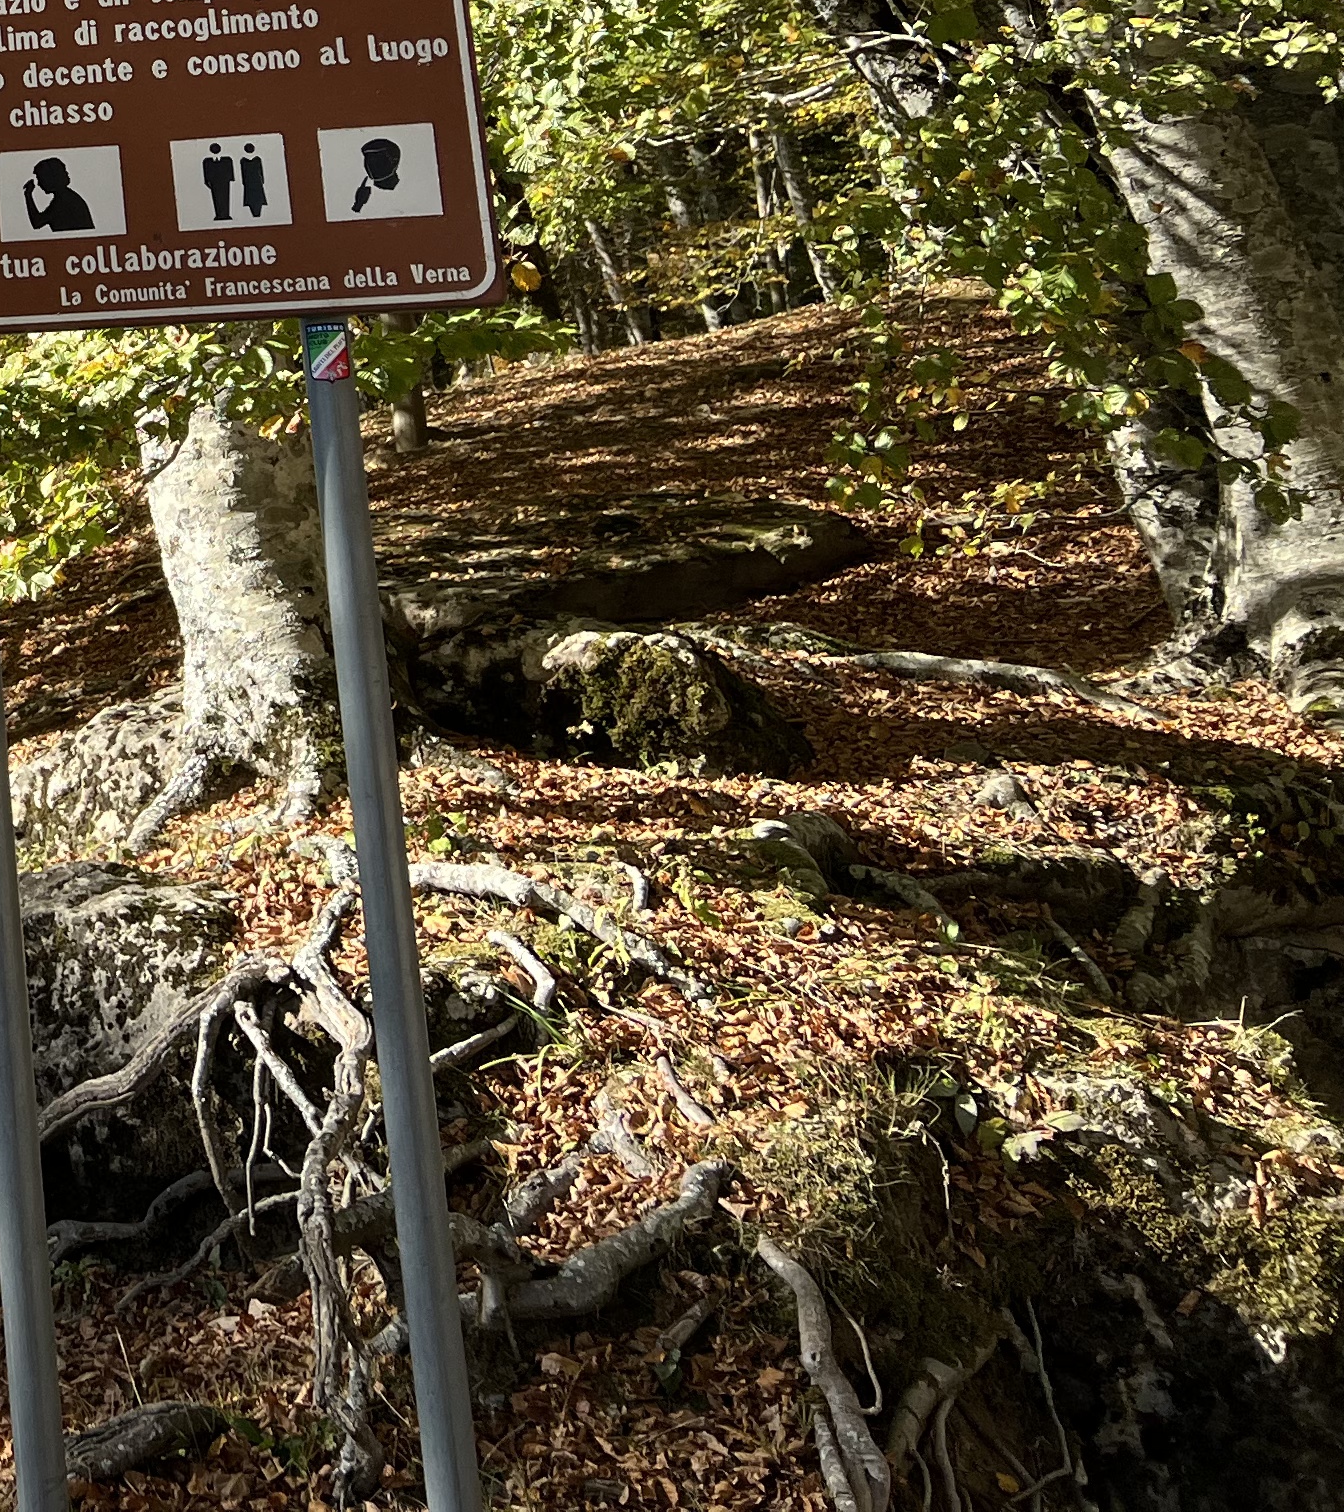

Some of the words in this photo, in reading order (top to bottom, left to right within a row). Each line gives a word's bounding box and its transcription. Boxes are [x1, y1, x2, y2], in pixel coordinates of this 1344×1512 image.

[74, 19, 98, 46] di
[114, 3, 319, 43] raccoglimento
[22, 57, 133, 88] decente
[151, 59, 168, 79] e
[187, 48, 300, 76] consono
[319, 36, 351, 66] al
[367, 34, 448, 64] luogo
[9, 100, 113, 128] chiasso
[0, 253, 47, 279] tua
[65, 244, 277, 275] collaborazione
[60, 286, 82, 307] La
[204, 275, 331, 298] Francescana
[343, 266, 398, 289] della
[409, 263, 471, 284] Verna
